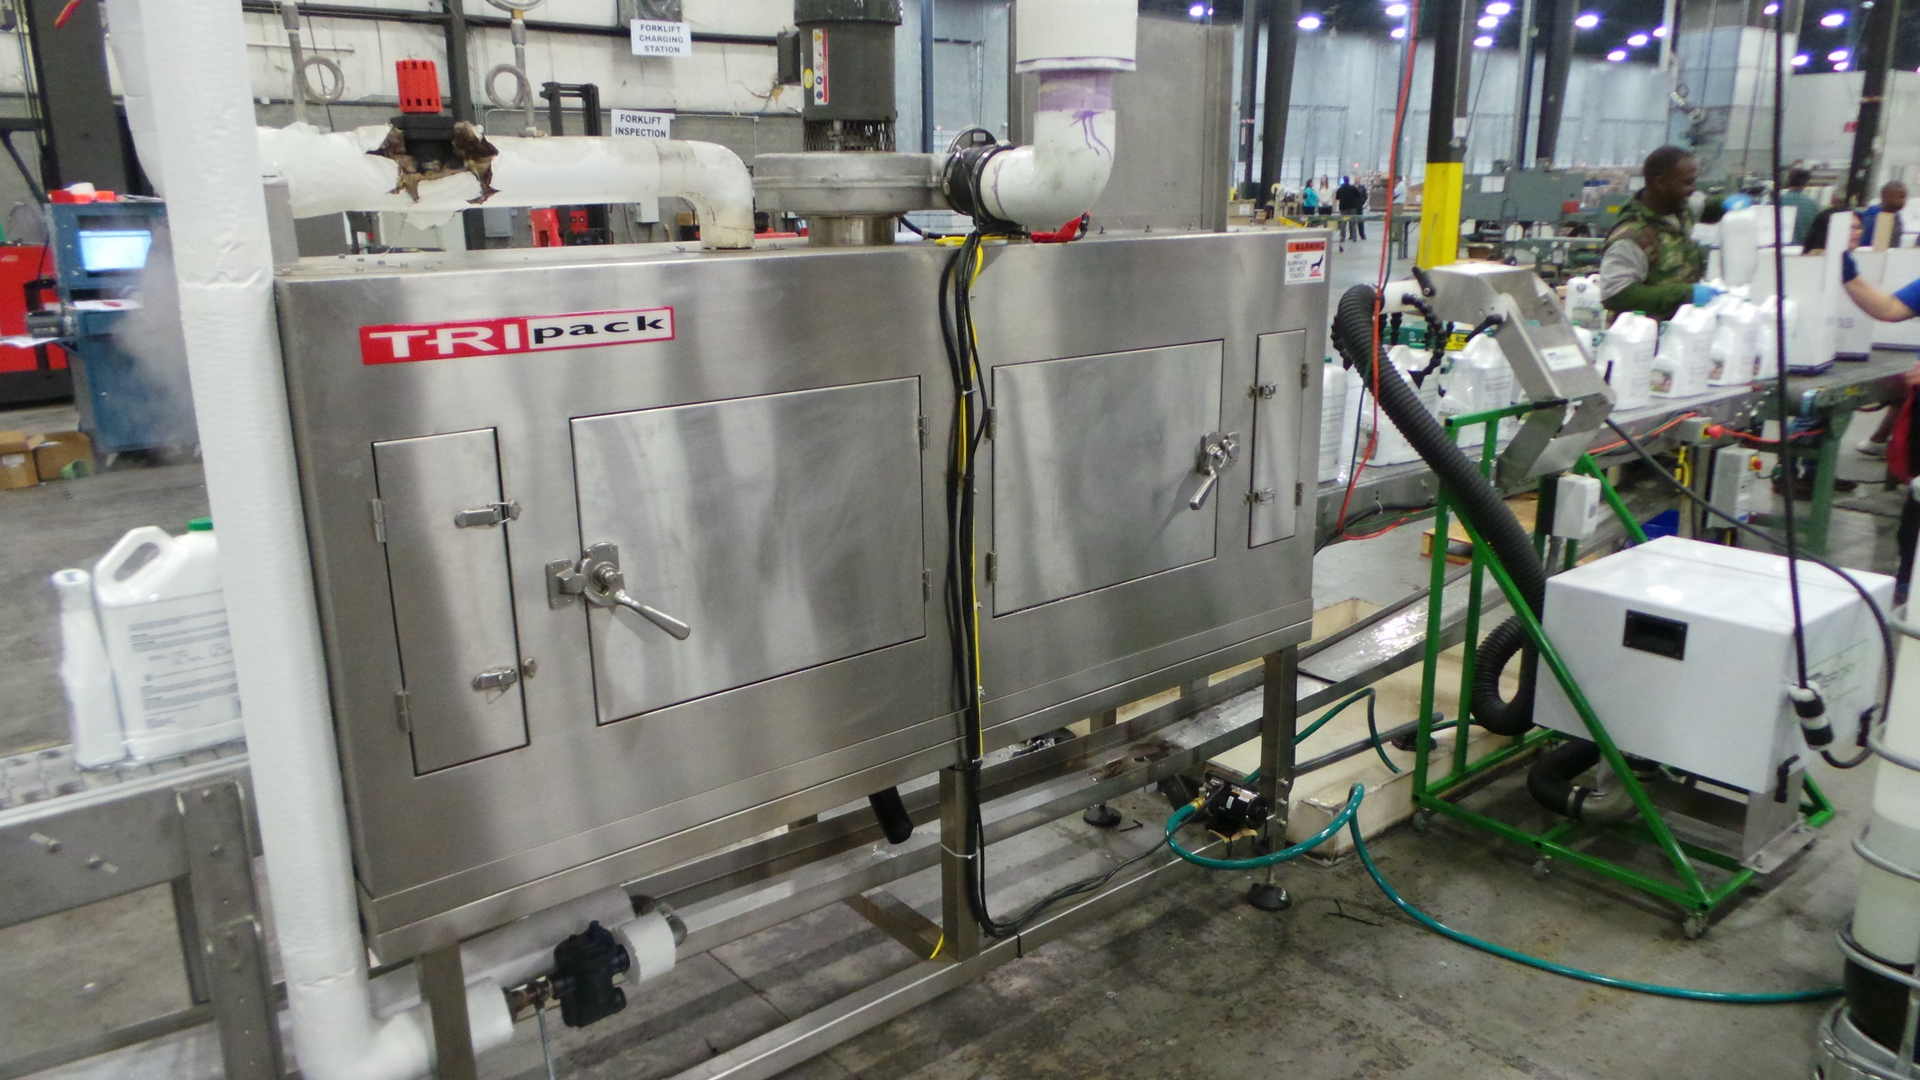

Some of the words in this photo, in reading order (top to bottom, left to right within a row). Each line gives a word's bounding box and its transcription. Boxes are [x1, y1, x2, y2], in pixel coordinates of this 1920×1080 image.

[640, 24, 681, 33] FORKLIFT
[639, 35, 684, 44] CHARGING
[644, 45, 680, 53] STATION
[620, 114, 661, 125] FORKLIFT
[615, 127, 667, 138] INSPECTION
[1295, 241, 1325, 250] WARNING
